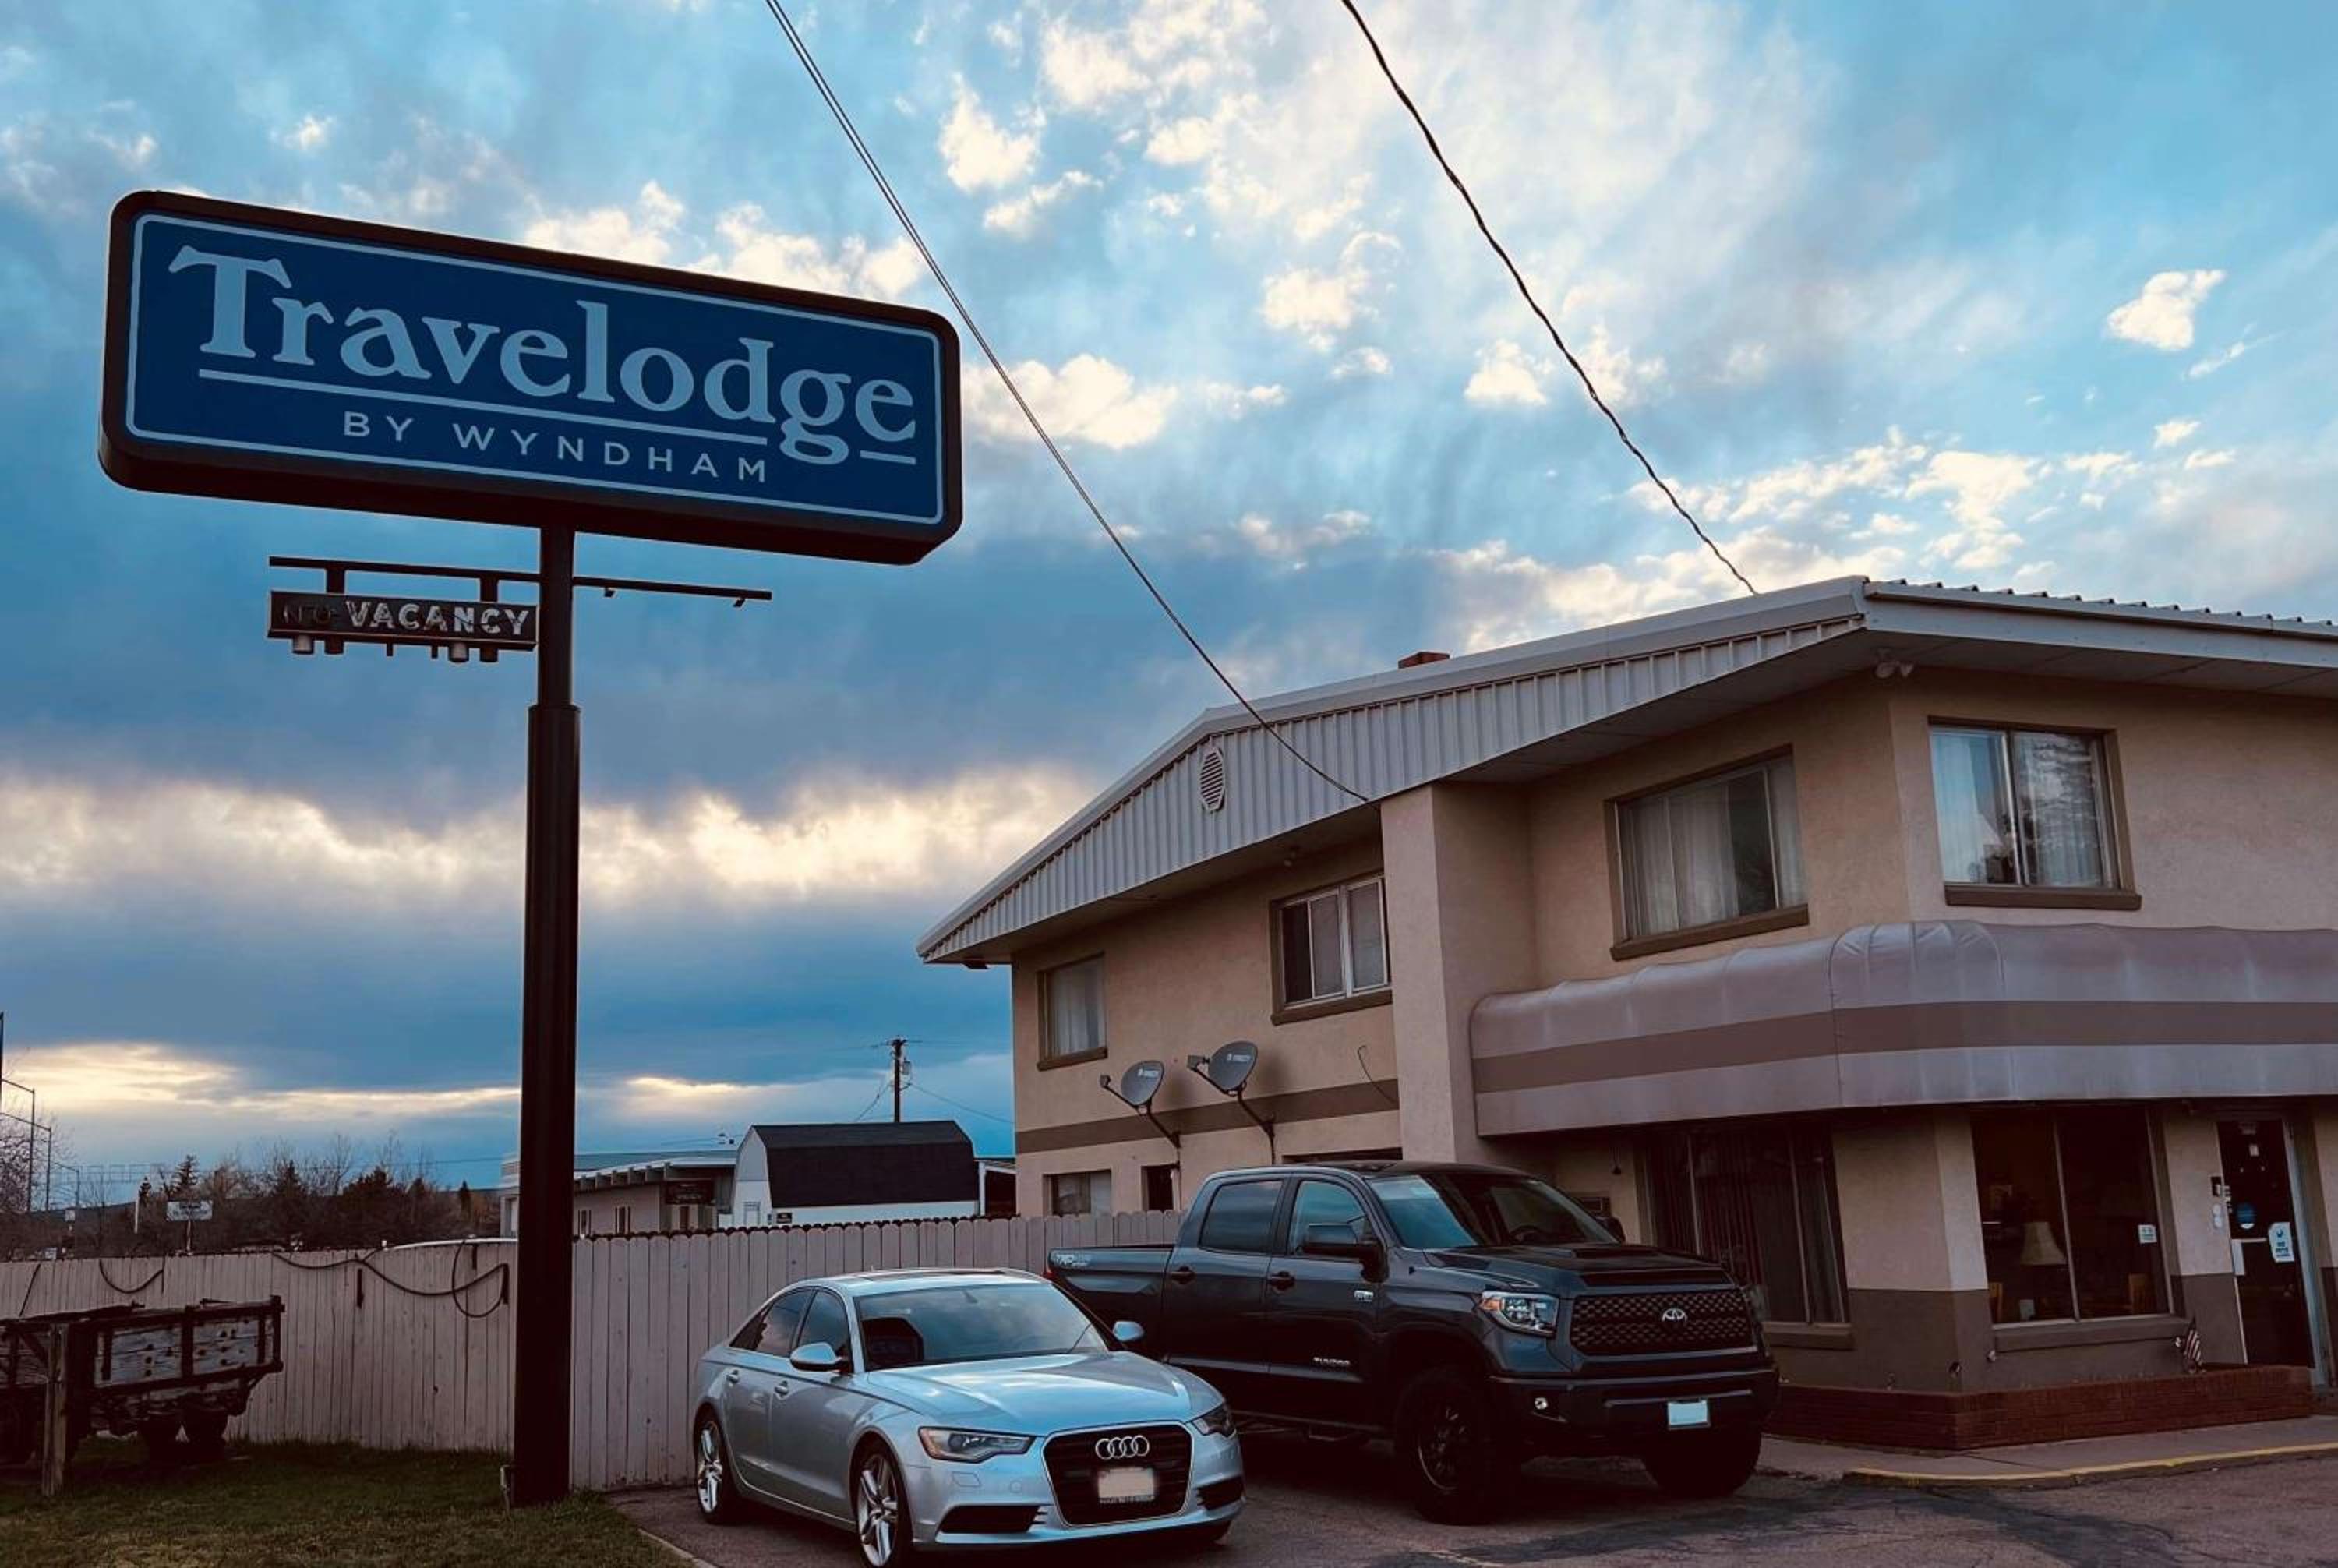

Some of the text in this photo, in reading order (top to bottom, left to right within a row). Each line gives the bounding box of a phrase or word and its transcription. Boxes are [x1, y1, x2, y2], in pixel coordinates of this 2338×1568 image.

[168, 244, 916, 466] Travelodge
[343, 410, 766, 483] BY WYNDHAM
[345, 600, 529, 635] VACANCY
